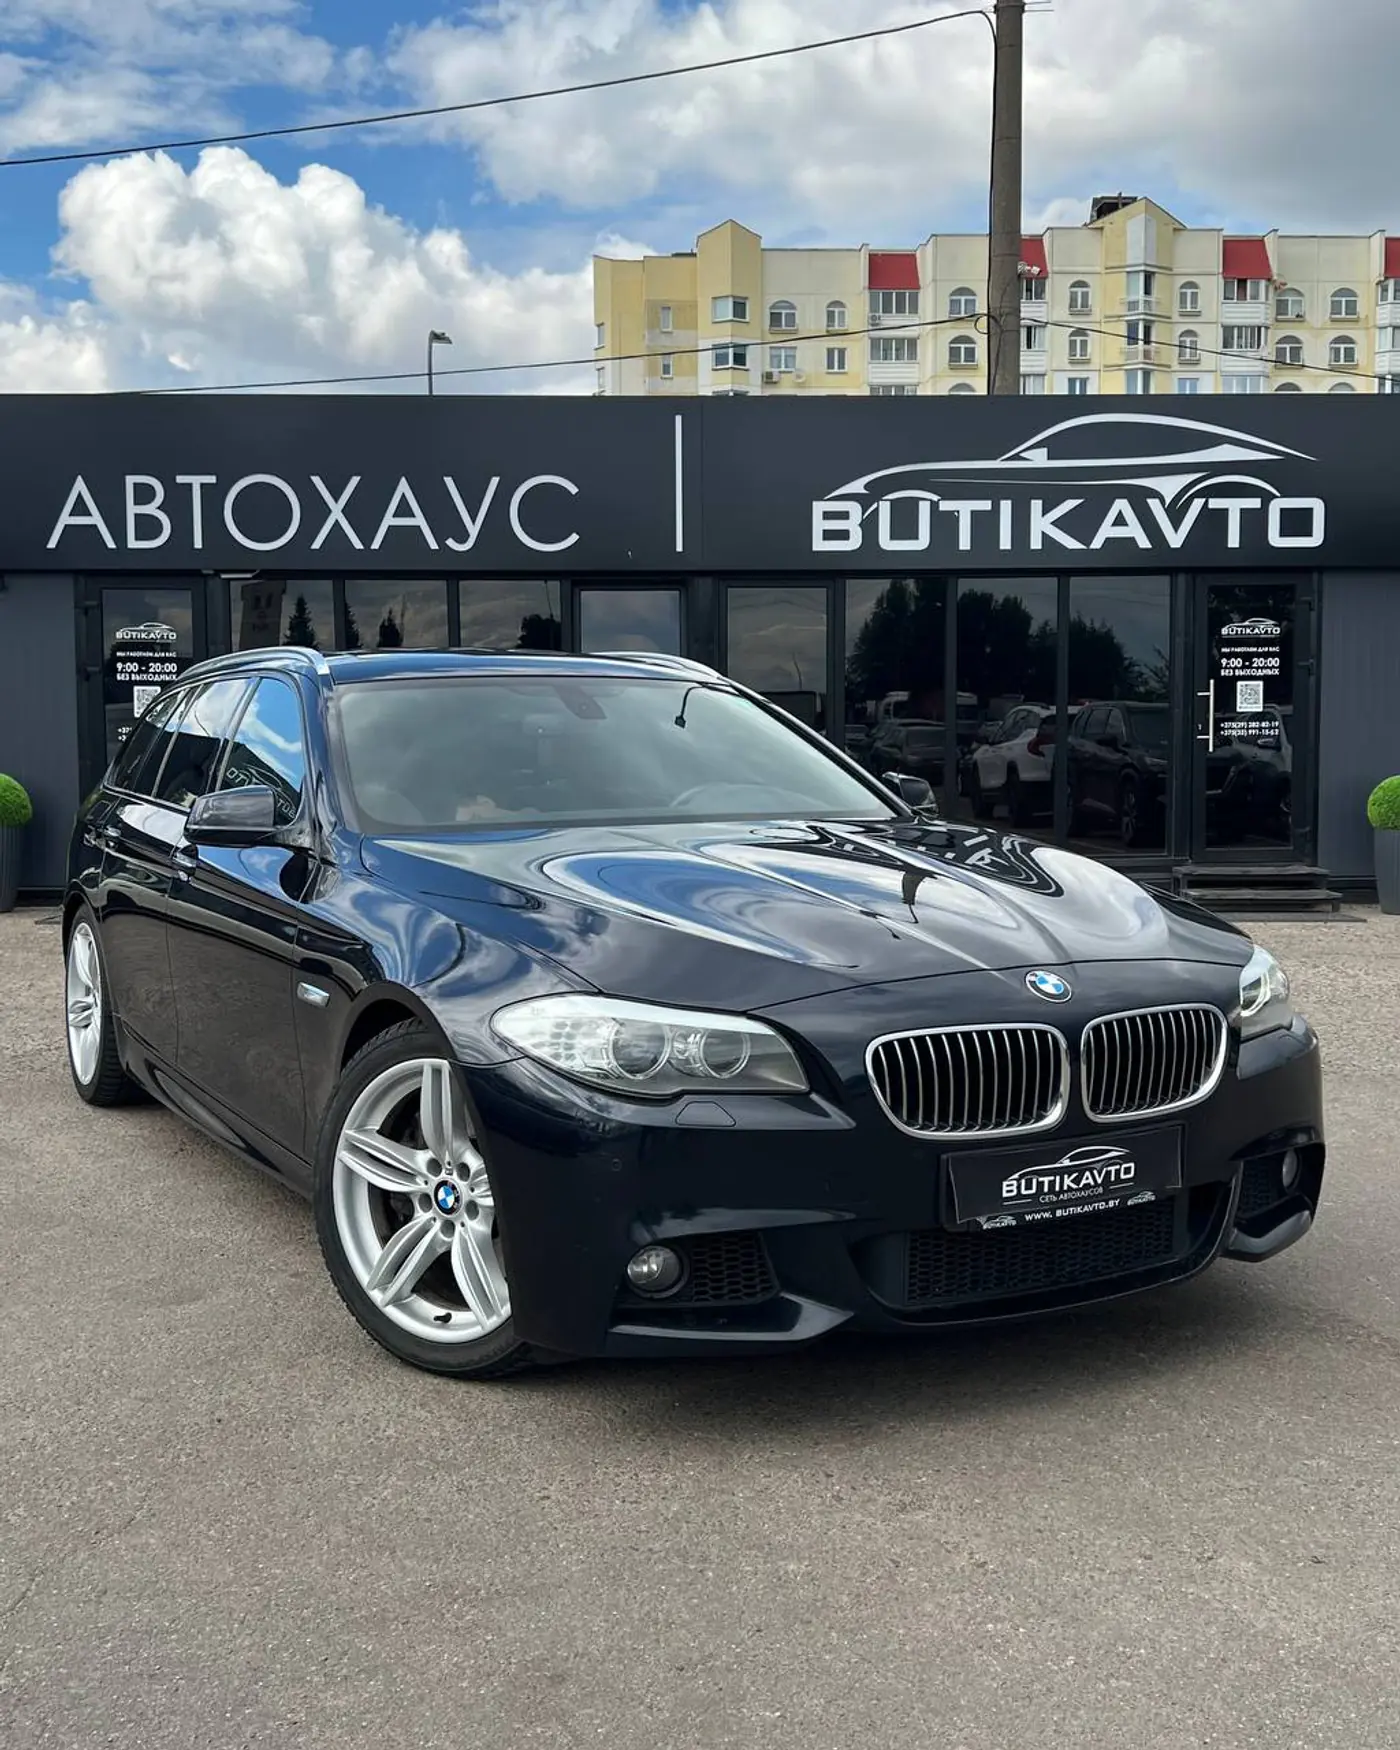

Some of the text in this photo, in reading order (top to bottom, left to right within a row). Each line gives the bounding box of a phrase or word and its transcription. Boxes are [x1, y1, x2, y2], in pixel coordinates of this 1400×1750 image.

[46, 474, 580, 552] АВТОХАУС
[811, 496, 1325, 551] BUTIKAVTO
[116, 631, 177, 640] BUTIKAVTO
[1221, 627, 1280, 635] BUTIKAVTO
[116, 662, 139, 672] 9:00
[149, 662, 178, 673] 20:00
[1221, 658, 1243, 668] 9:00
[1252, 657, 1280, 667] 20:00
[116, 673, 177, 681] БЕЗ ВЫХОДНЫХ
[1221, 668, 1280, 676] БЕЗ ВЫХОДНЫХ
[1002, 1162, 1135, 1198] BUTIKAVTO
[1040, 1194, 1057, 1203] СЕТЬ
[1056, 1198, 1120, 1217] BUTIKAVTO.BY
